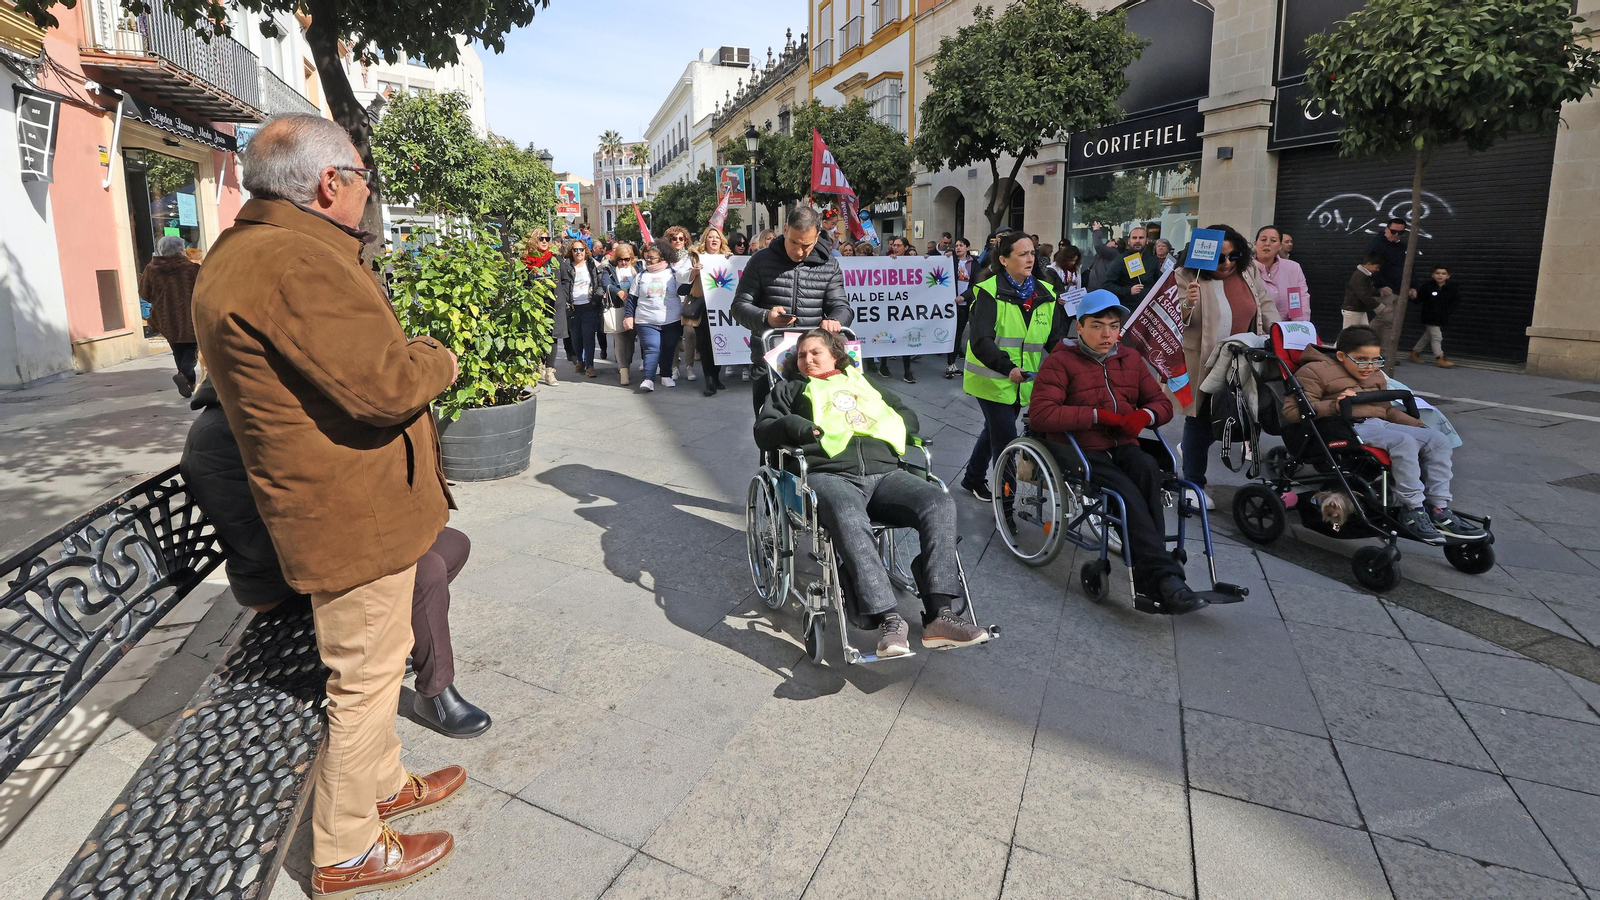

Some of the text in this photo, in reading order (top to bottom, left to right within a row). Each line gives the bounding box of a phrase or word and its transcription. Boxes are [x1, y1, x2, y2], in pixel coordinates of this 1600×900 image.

[1083, 124, 1186, 158] CORTEFIEL
[874, 201, 899, 214] MOMOKO
[842, 268, 923, 286] NVISIBLES
[870, 292, 885, 301] DE
[888, 291, 909, 300] LAS
[707, 303, 955, 326] EN ES RARAS
[1160, 299, 1180, 323] SEGUIR
[1146, 322, 1158, 339] FUESE
[1160, 340, 1175, 356] HIJO?
[1284, 323, 1311, 336] UNIPER
